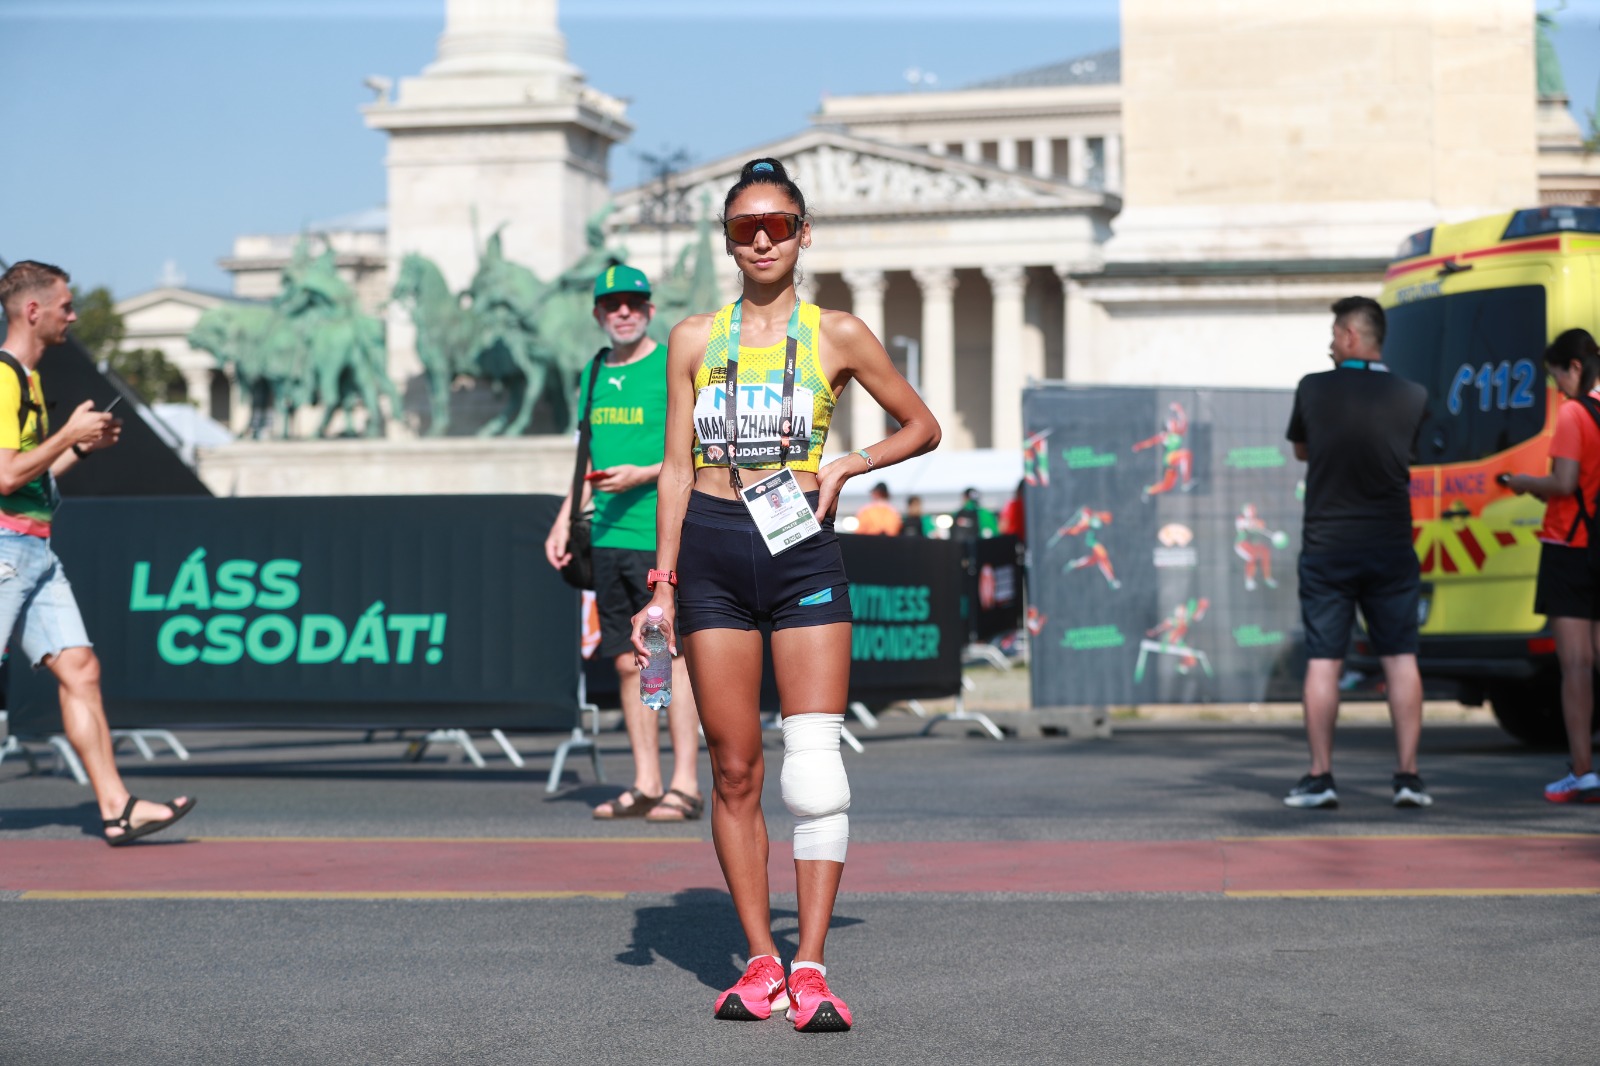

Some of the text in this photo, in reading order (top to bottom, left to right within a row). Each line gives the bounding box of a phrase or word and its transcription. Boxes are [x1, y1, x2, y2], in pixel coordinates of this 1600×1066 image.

[1475, 358, 1536, 412] 112
[735, 444, 802, 457] UDAPES 23
[130, 547, 302, 611] LÁSS
[157, 600, 447, 666] CSODÁT!
